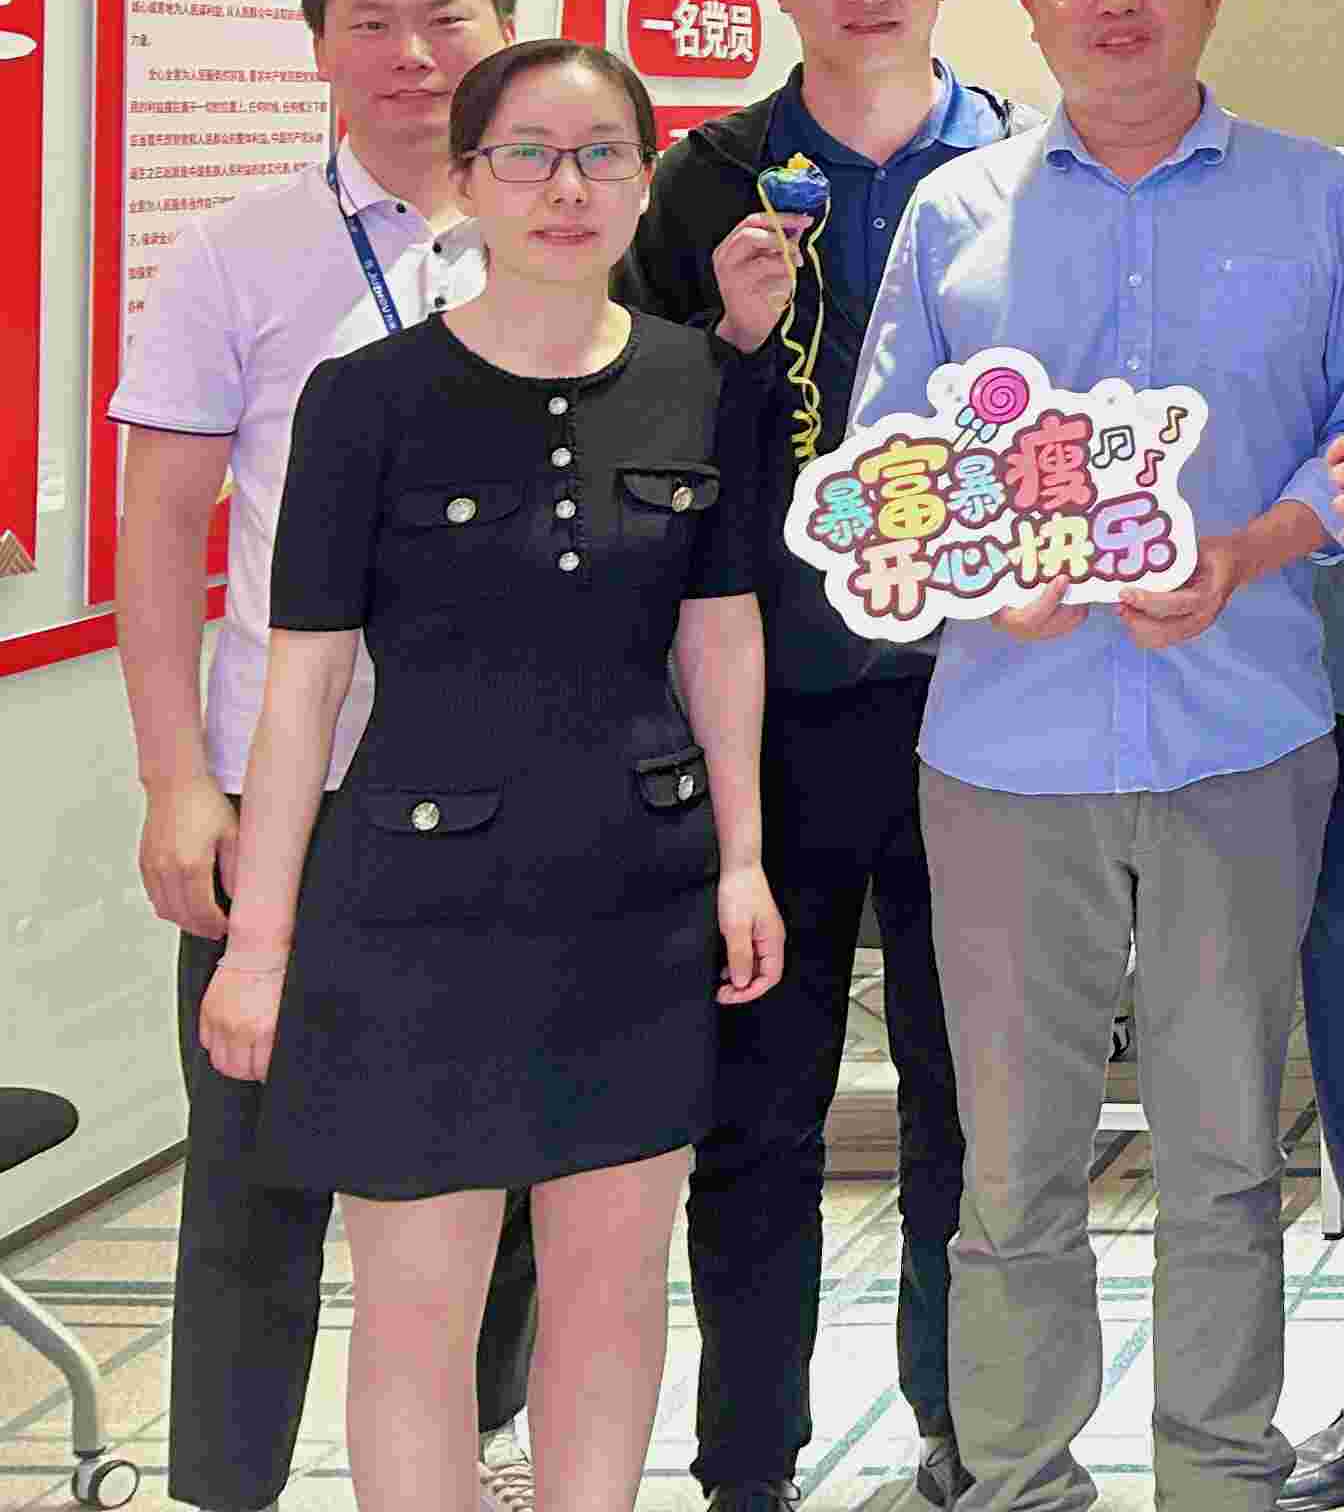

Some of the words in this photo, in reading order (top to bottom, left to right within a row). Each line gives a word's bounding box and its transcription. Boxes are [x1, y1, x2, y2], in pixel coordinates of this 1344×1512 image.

[808, 409, 1098, 553] 暴富暴瘦
[848, 492, 1176, 621] 开心快乐
